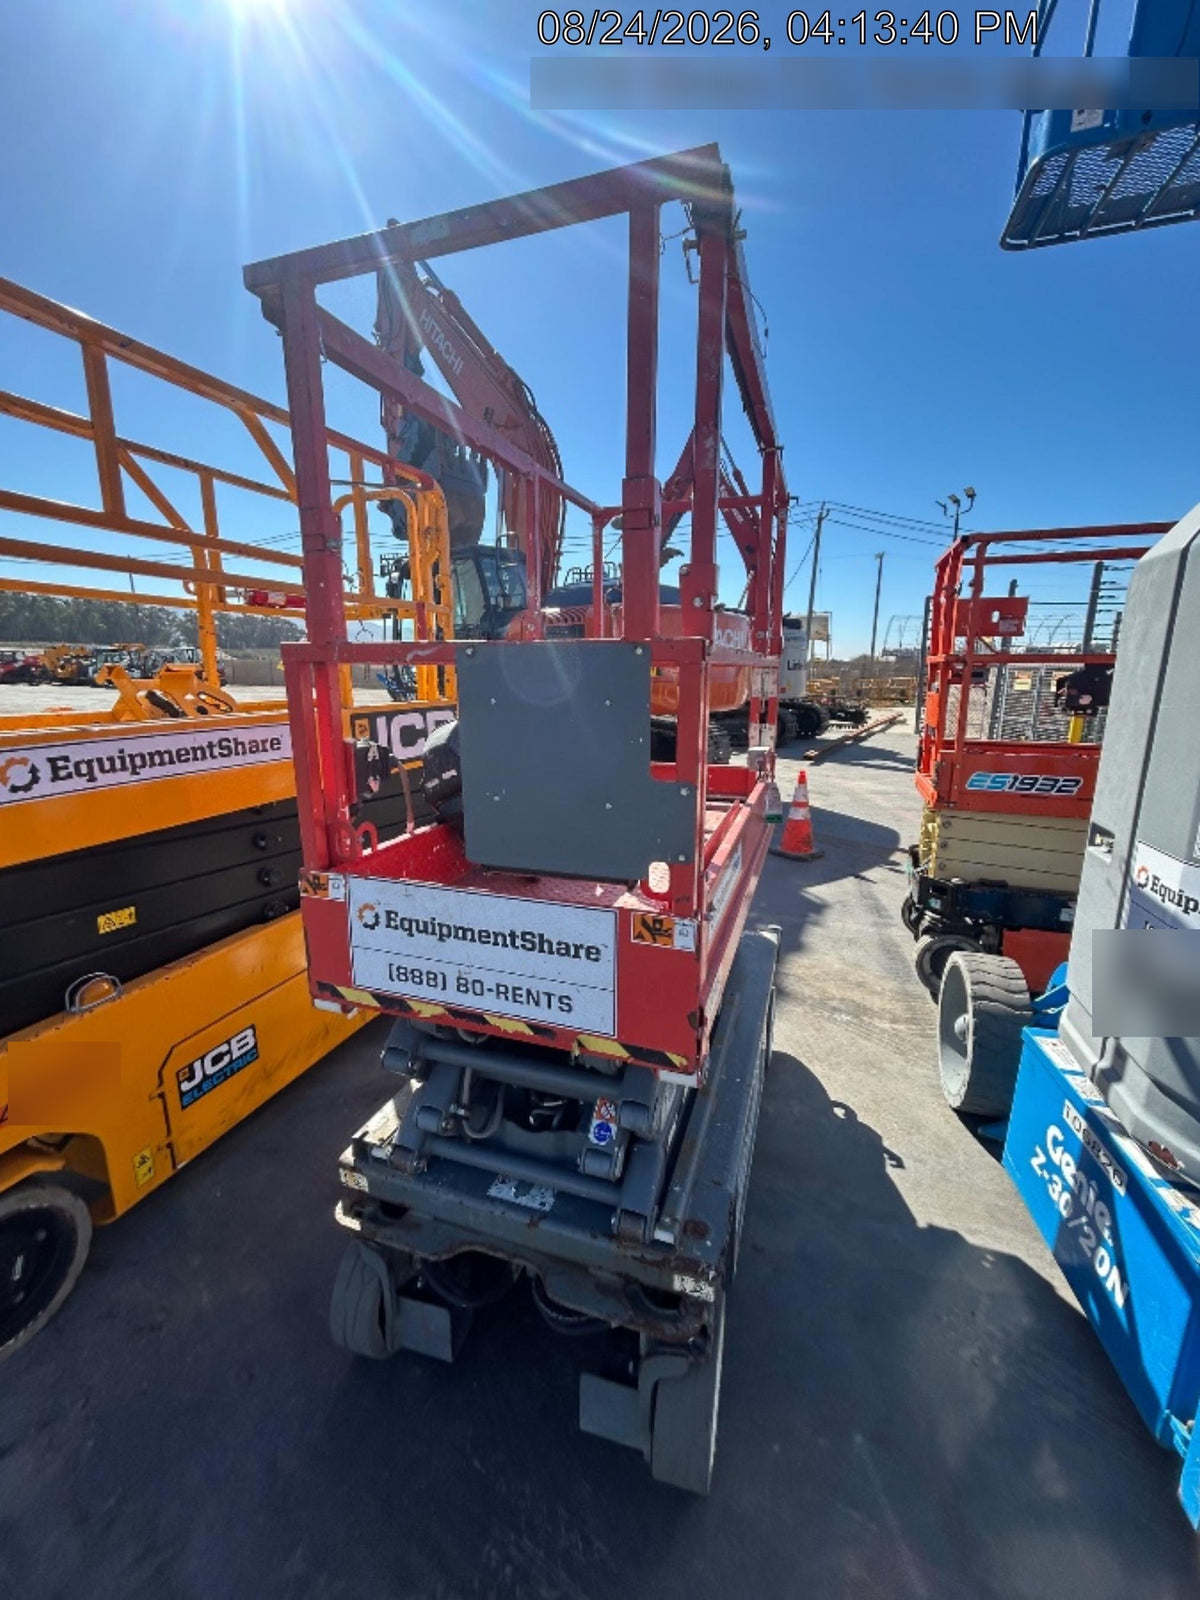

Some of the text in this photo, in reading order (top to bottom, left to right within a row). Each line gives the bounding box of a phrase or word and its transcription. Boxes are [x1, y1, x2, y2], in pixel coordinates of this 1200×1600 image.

[420, 308, 464, 376] HITACHI
[46, 737, 282, 783] EquipmentShare
[966, 771, 1083, 795] ES1932
[1150, 874, 1200, 916] Equip
[384, 909, 602, 963] EquipmentShare
[388, 963, 574, 1014] (888) 80-RENTS
[180, 1028, 255, 1092] JCB
[182, 1047, 258, 1107] ELECTRIC
[1046, 1124, 1112, 1246] Genie
[1031, 1145, 1129, 1309] Z-30/20N
